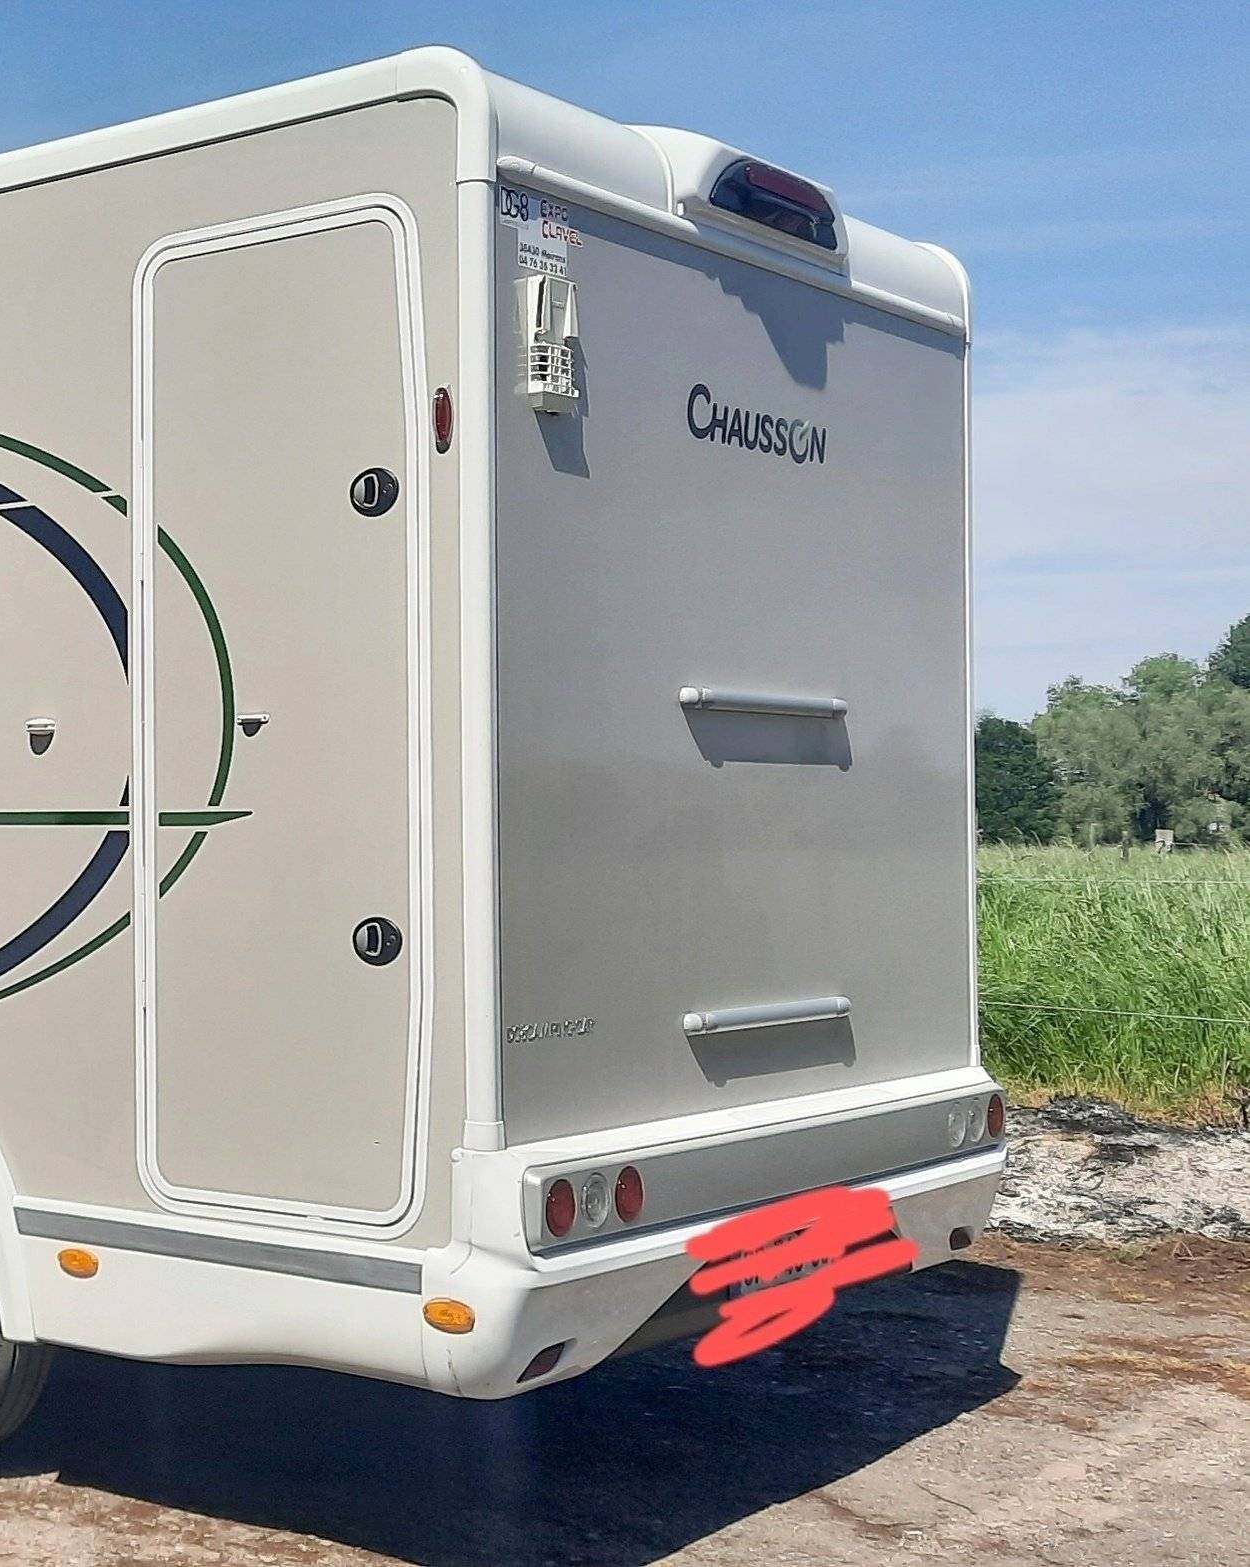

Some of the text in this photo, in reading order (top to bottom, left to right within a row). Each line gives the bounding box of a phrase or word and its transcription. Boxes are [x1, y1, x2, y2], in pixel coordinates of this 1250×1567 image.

[540, 199, 568, 221] EXPO
[541, 220, 582, 246] CLAVEL
[530, 257, 538, 268] 76
